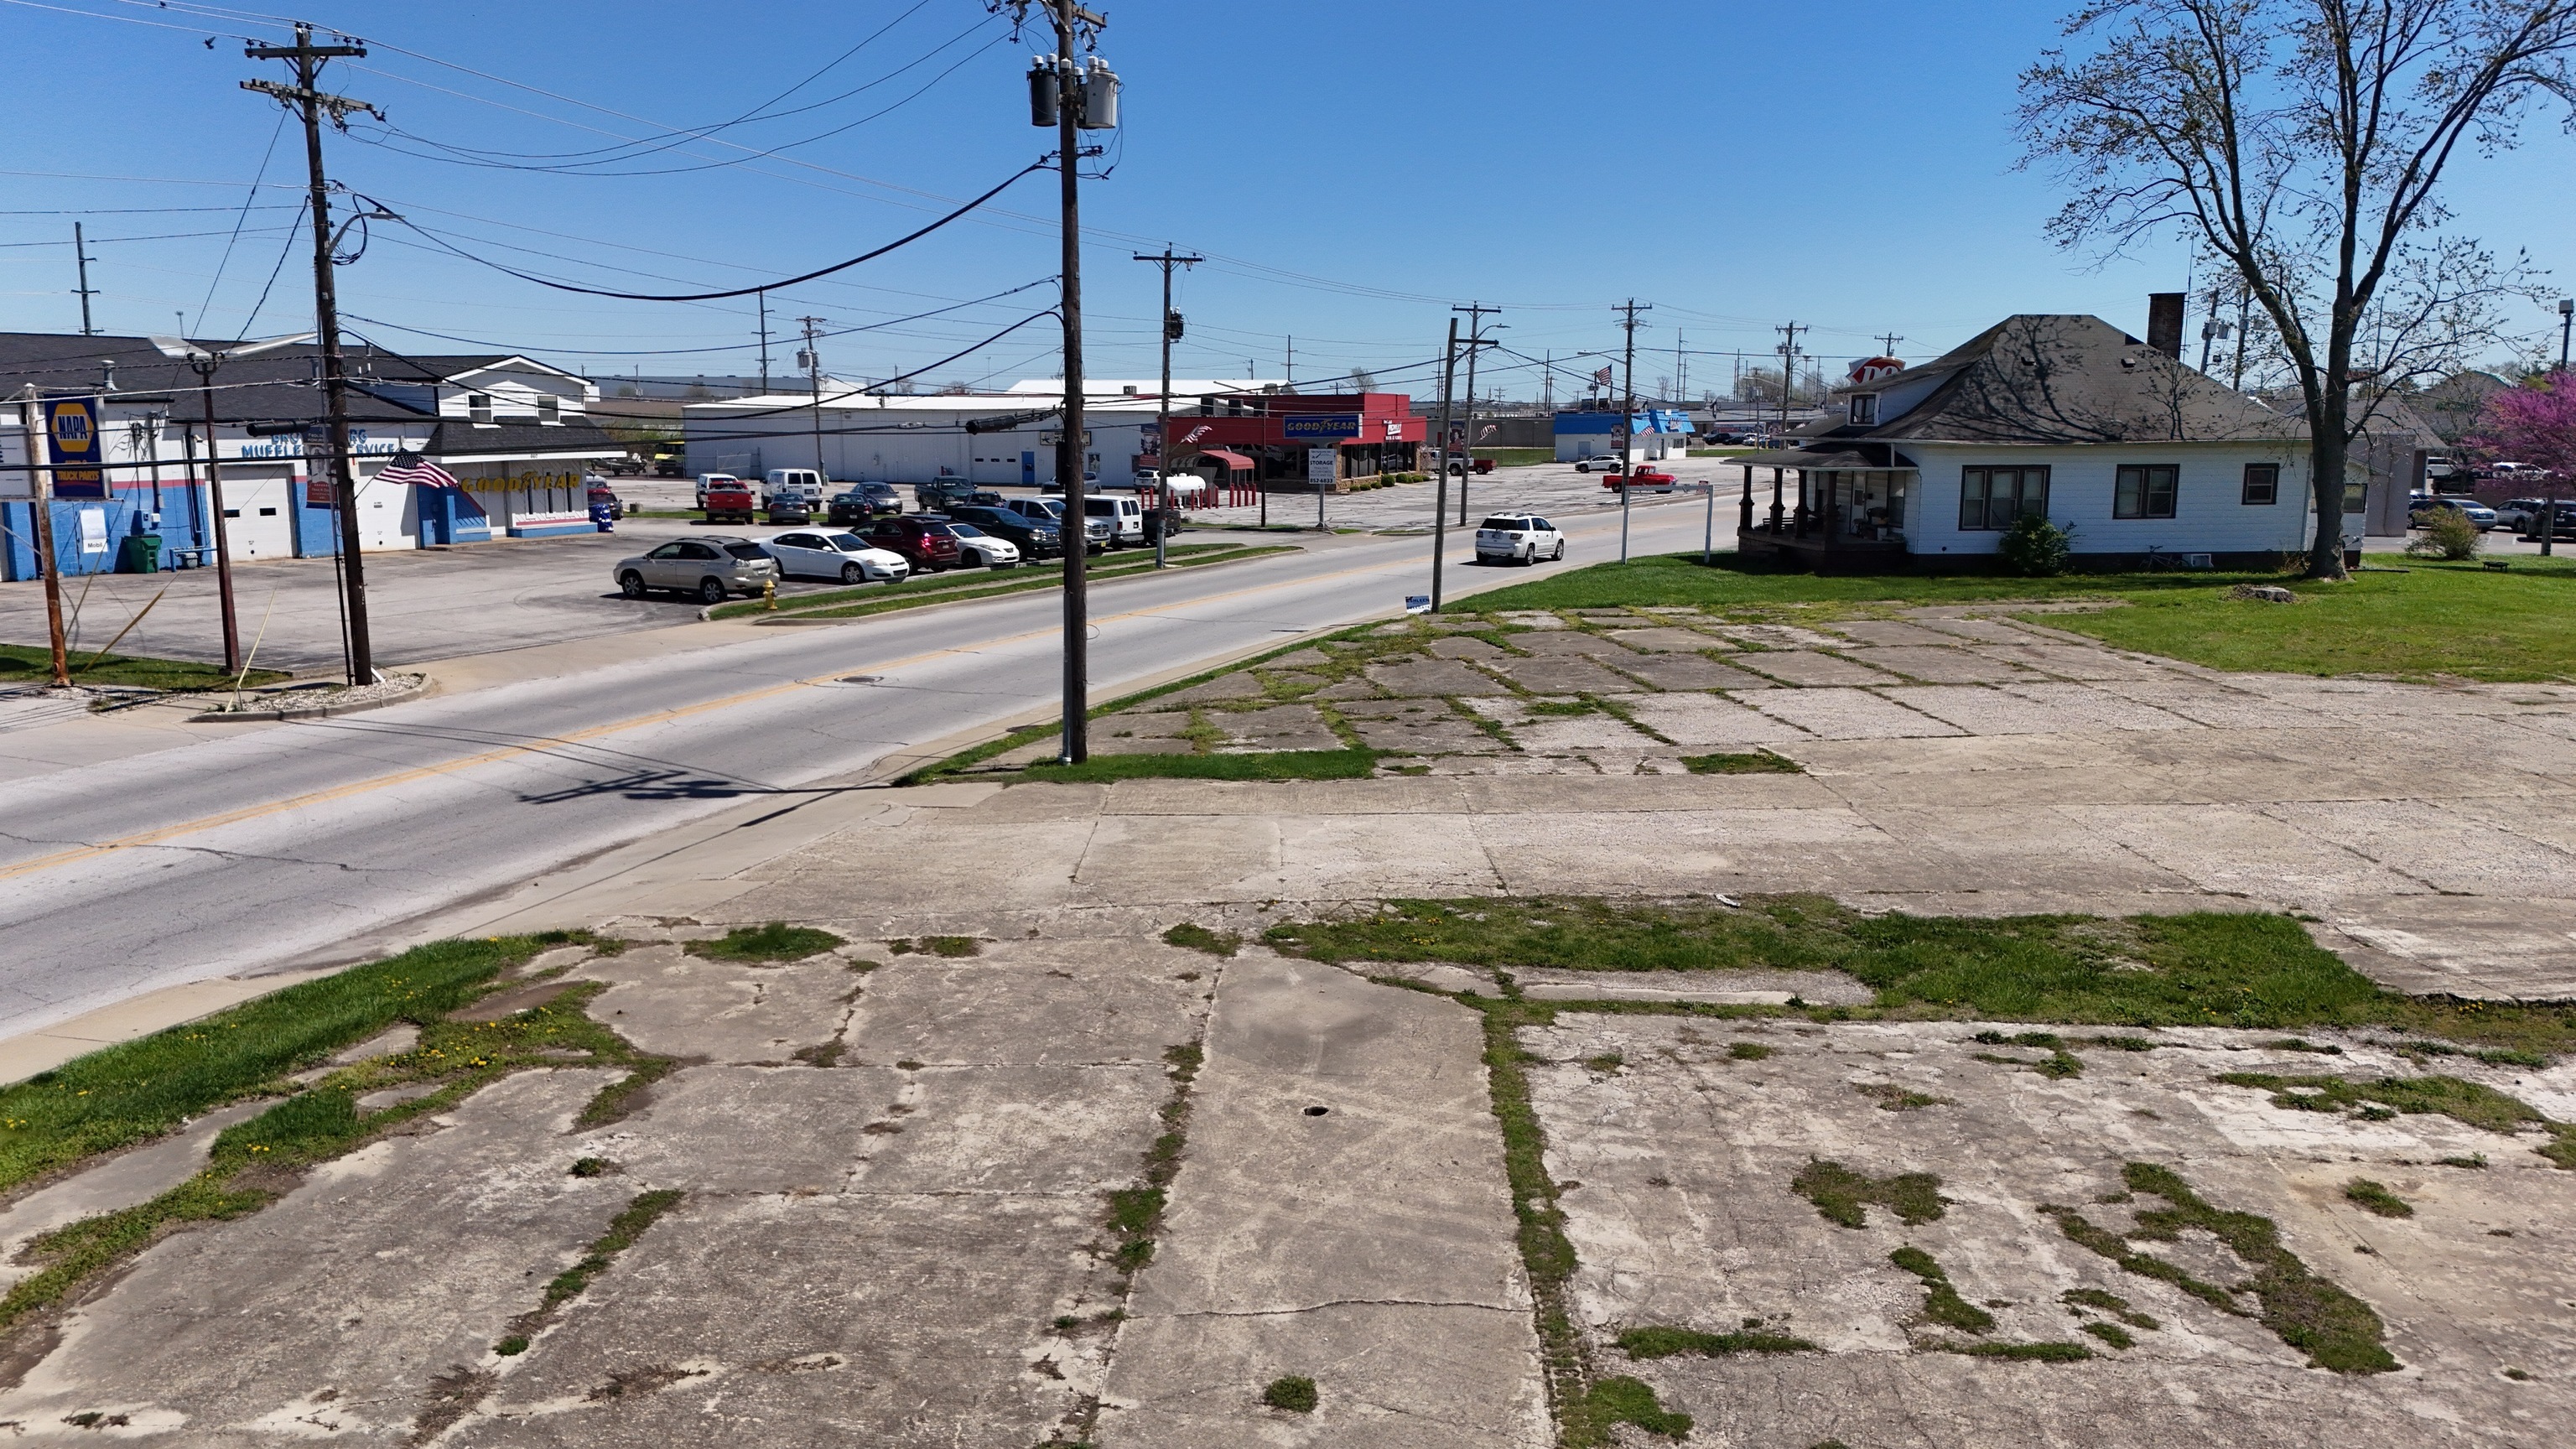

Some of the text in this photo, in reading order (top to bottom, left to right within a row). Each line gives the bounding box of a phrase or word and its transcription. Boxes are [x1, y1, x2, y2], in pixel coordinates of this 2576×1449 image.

[57, 416, 87, 439] NAPA
[1287, 419, 1356, 433] GOODYEAR
[242, 445, 304, 457] MUFFLE
[56, 471, 99, 480] TRUCK PARTS
[461, 471, 581, 493] GOODYEAR
